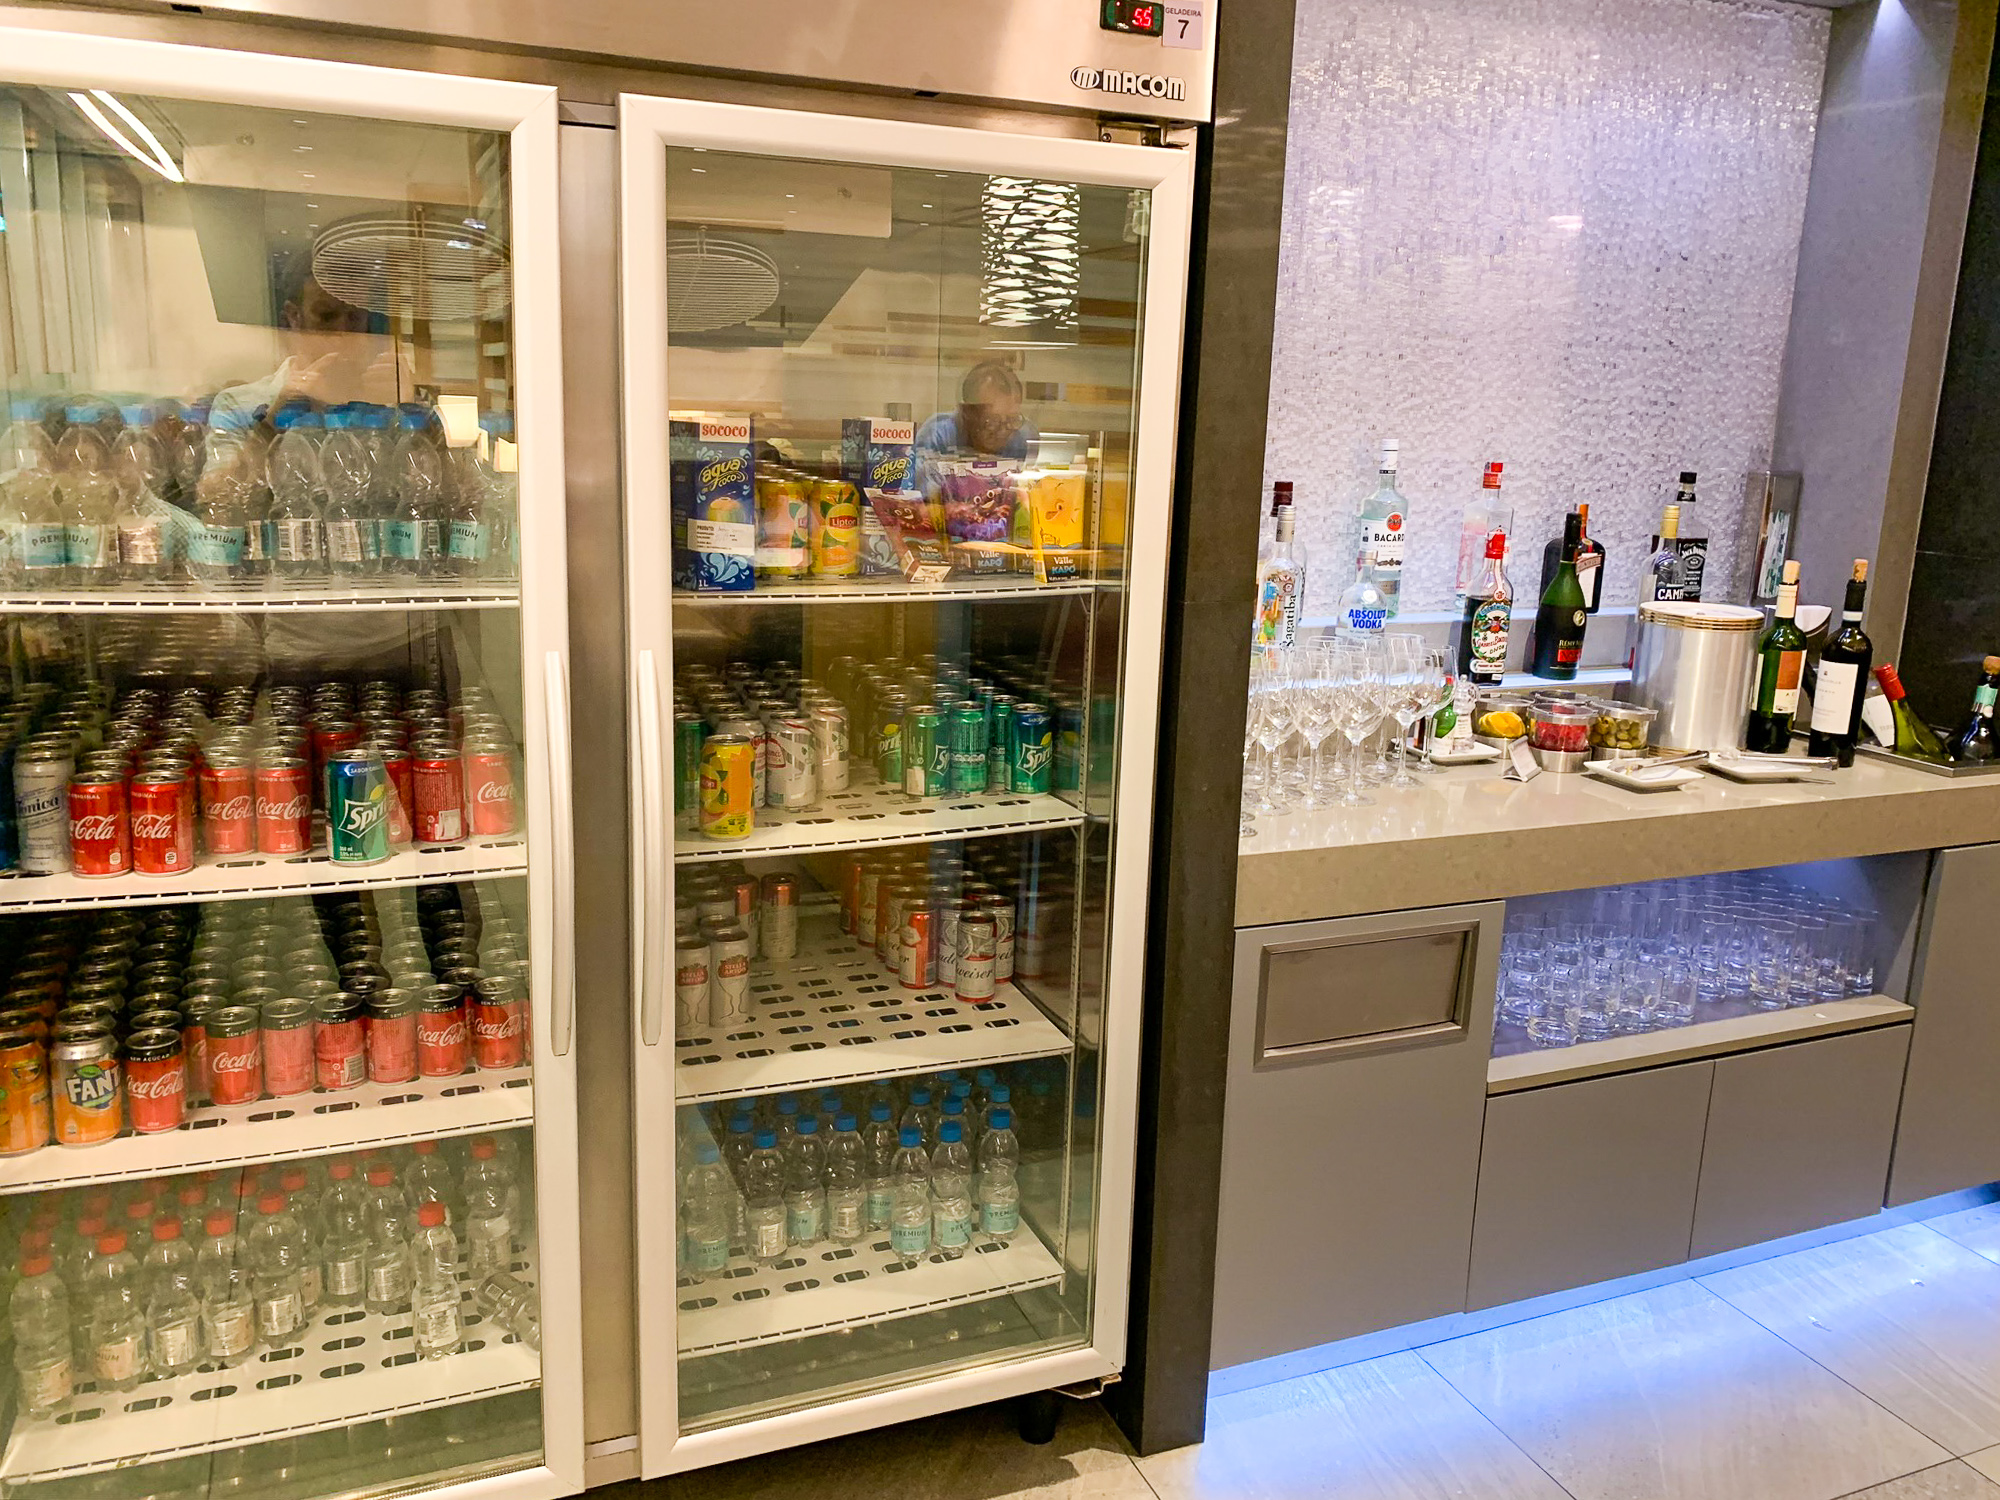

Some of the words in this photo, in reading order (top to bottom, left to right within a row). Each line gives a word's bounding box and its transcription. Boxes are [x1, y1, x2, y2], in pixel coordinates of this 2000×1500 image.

[1165, 7, 1201, 17] GELADEIRA
[1178, 19, 1189, 39] 7
[1102, 69, 1186, 101] MACOM
[702, 425, 747, 437] SOCOCO
[873, 427, 911, 440] SOCOCO
[1374, 533, 1405, 542] BACARD
[1348, 608, 1386, 619] ABSOLUT
[1281, 595, 1297, 649] Sagatiba
[1352, 618, 1382, 629] VODKA
